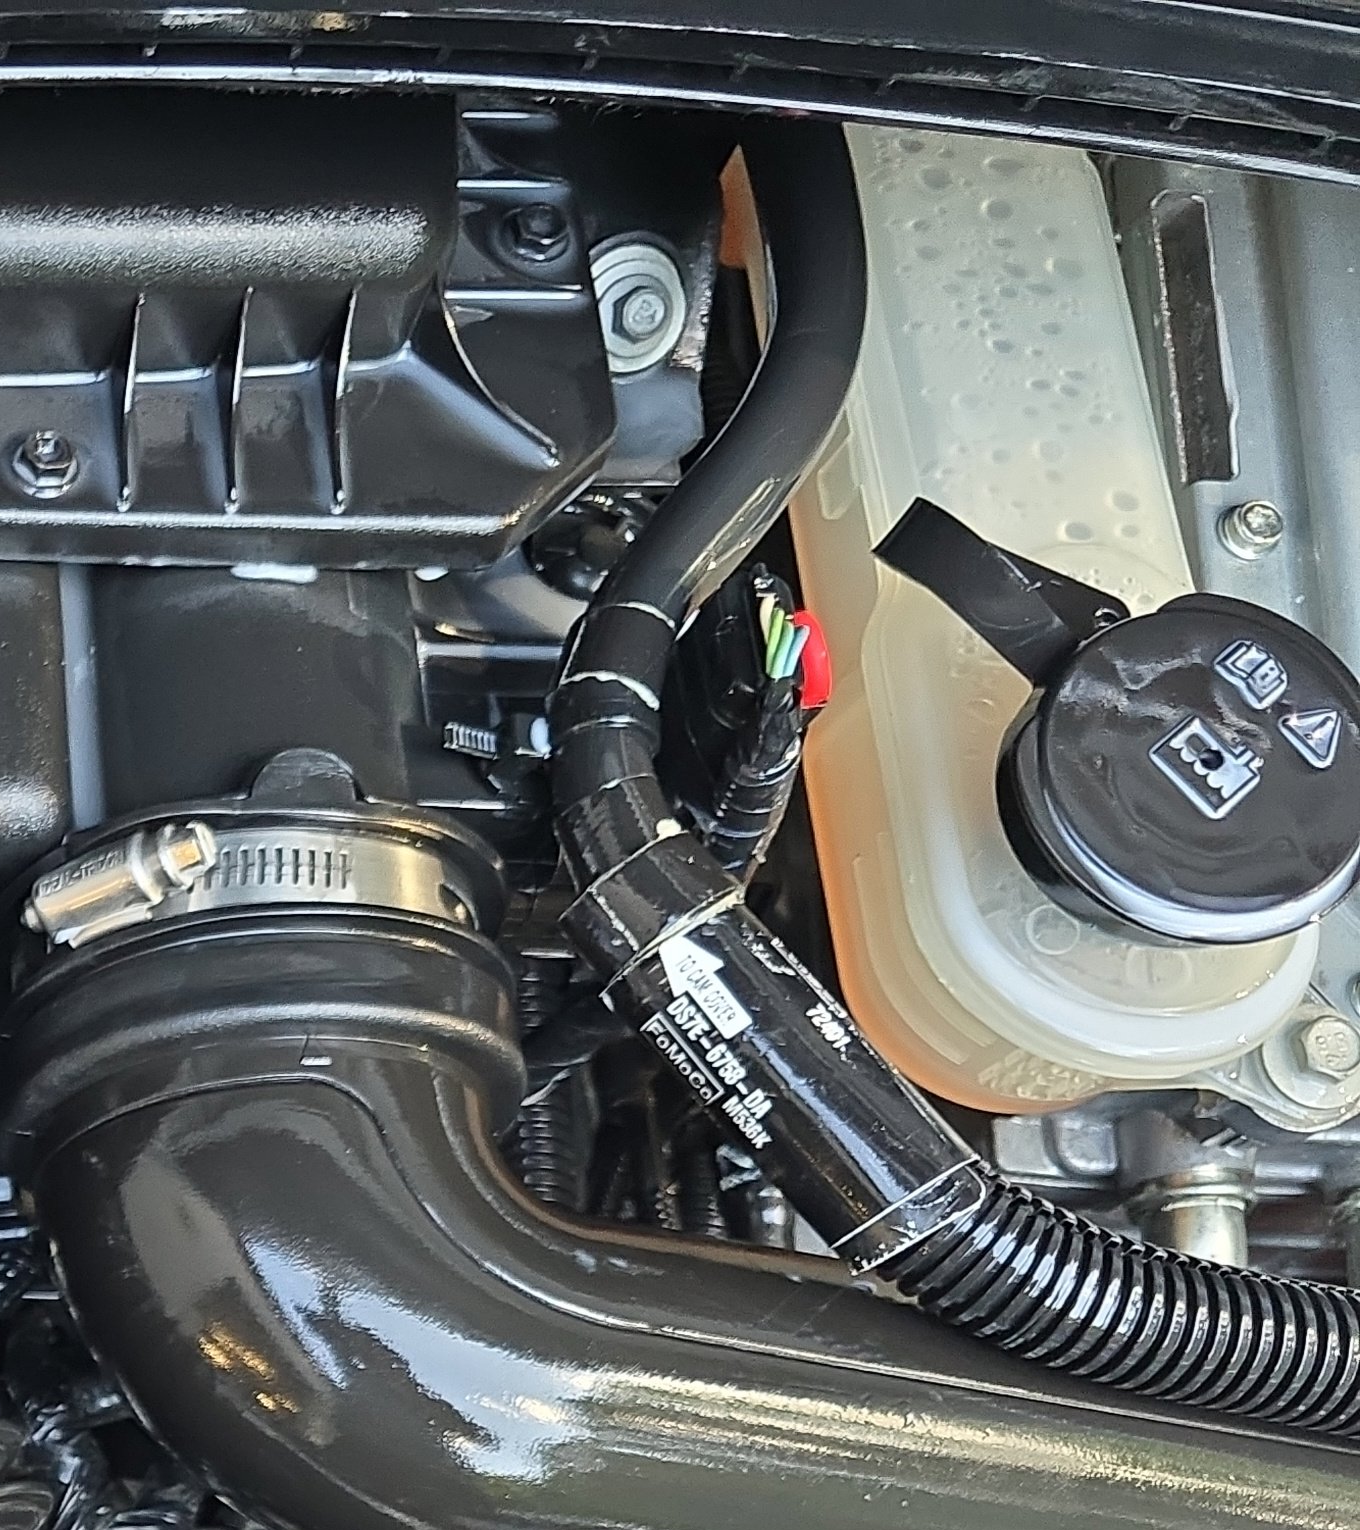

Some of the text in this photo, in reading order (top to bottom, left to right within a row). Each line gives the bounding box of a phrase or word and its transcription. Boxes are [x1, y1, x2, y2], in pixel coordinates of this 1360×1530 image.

[646, 1018, 773, 1150] FoMoCo M536K
[665, 992, 773, 1121] DS7E-6758-DA
